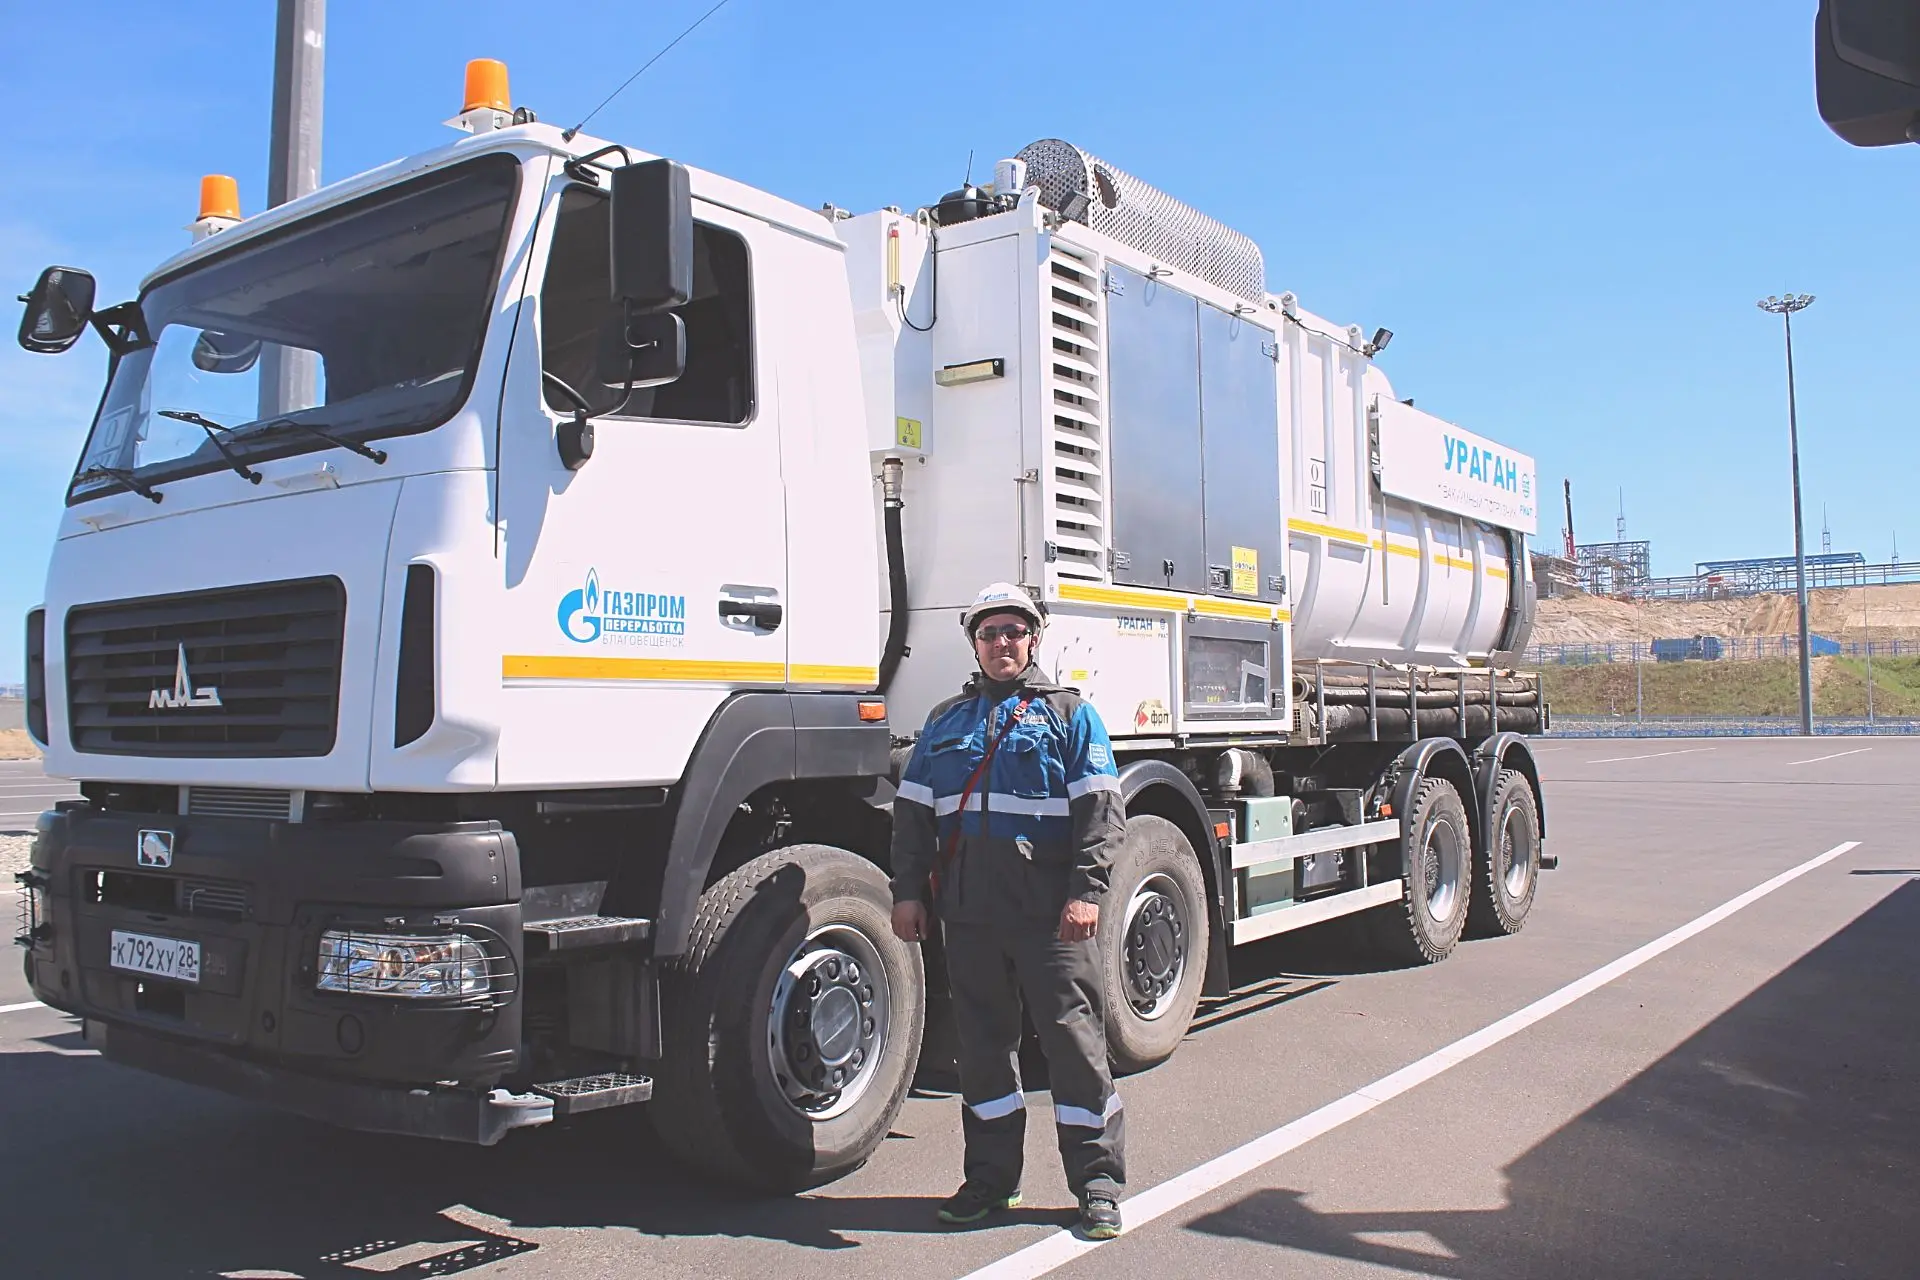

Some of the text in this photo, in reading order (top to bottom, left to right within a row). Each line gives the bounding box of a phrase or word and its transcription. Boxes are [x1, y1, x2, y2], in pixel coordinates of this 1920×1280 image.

[1443, 434, 1517, 493] УРАГАН
[603, 590, 685, 619] ГАЗПРОМ
[604, 618, 684, 635] ПЕРЕРАБОТКА
[1117, 616, 1153, 630] УРАГАН
[602, 633, 684, 648] БЛАГОВЕЩЕНСК
[178, 944, 194, 968] 28
